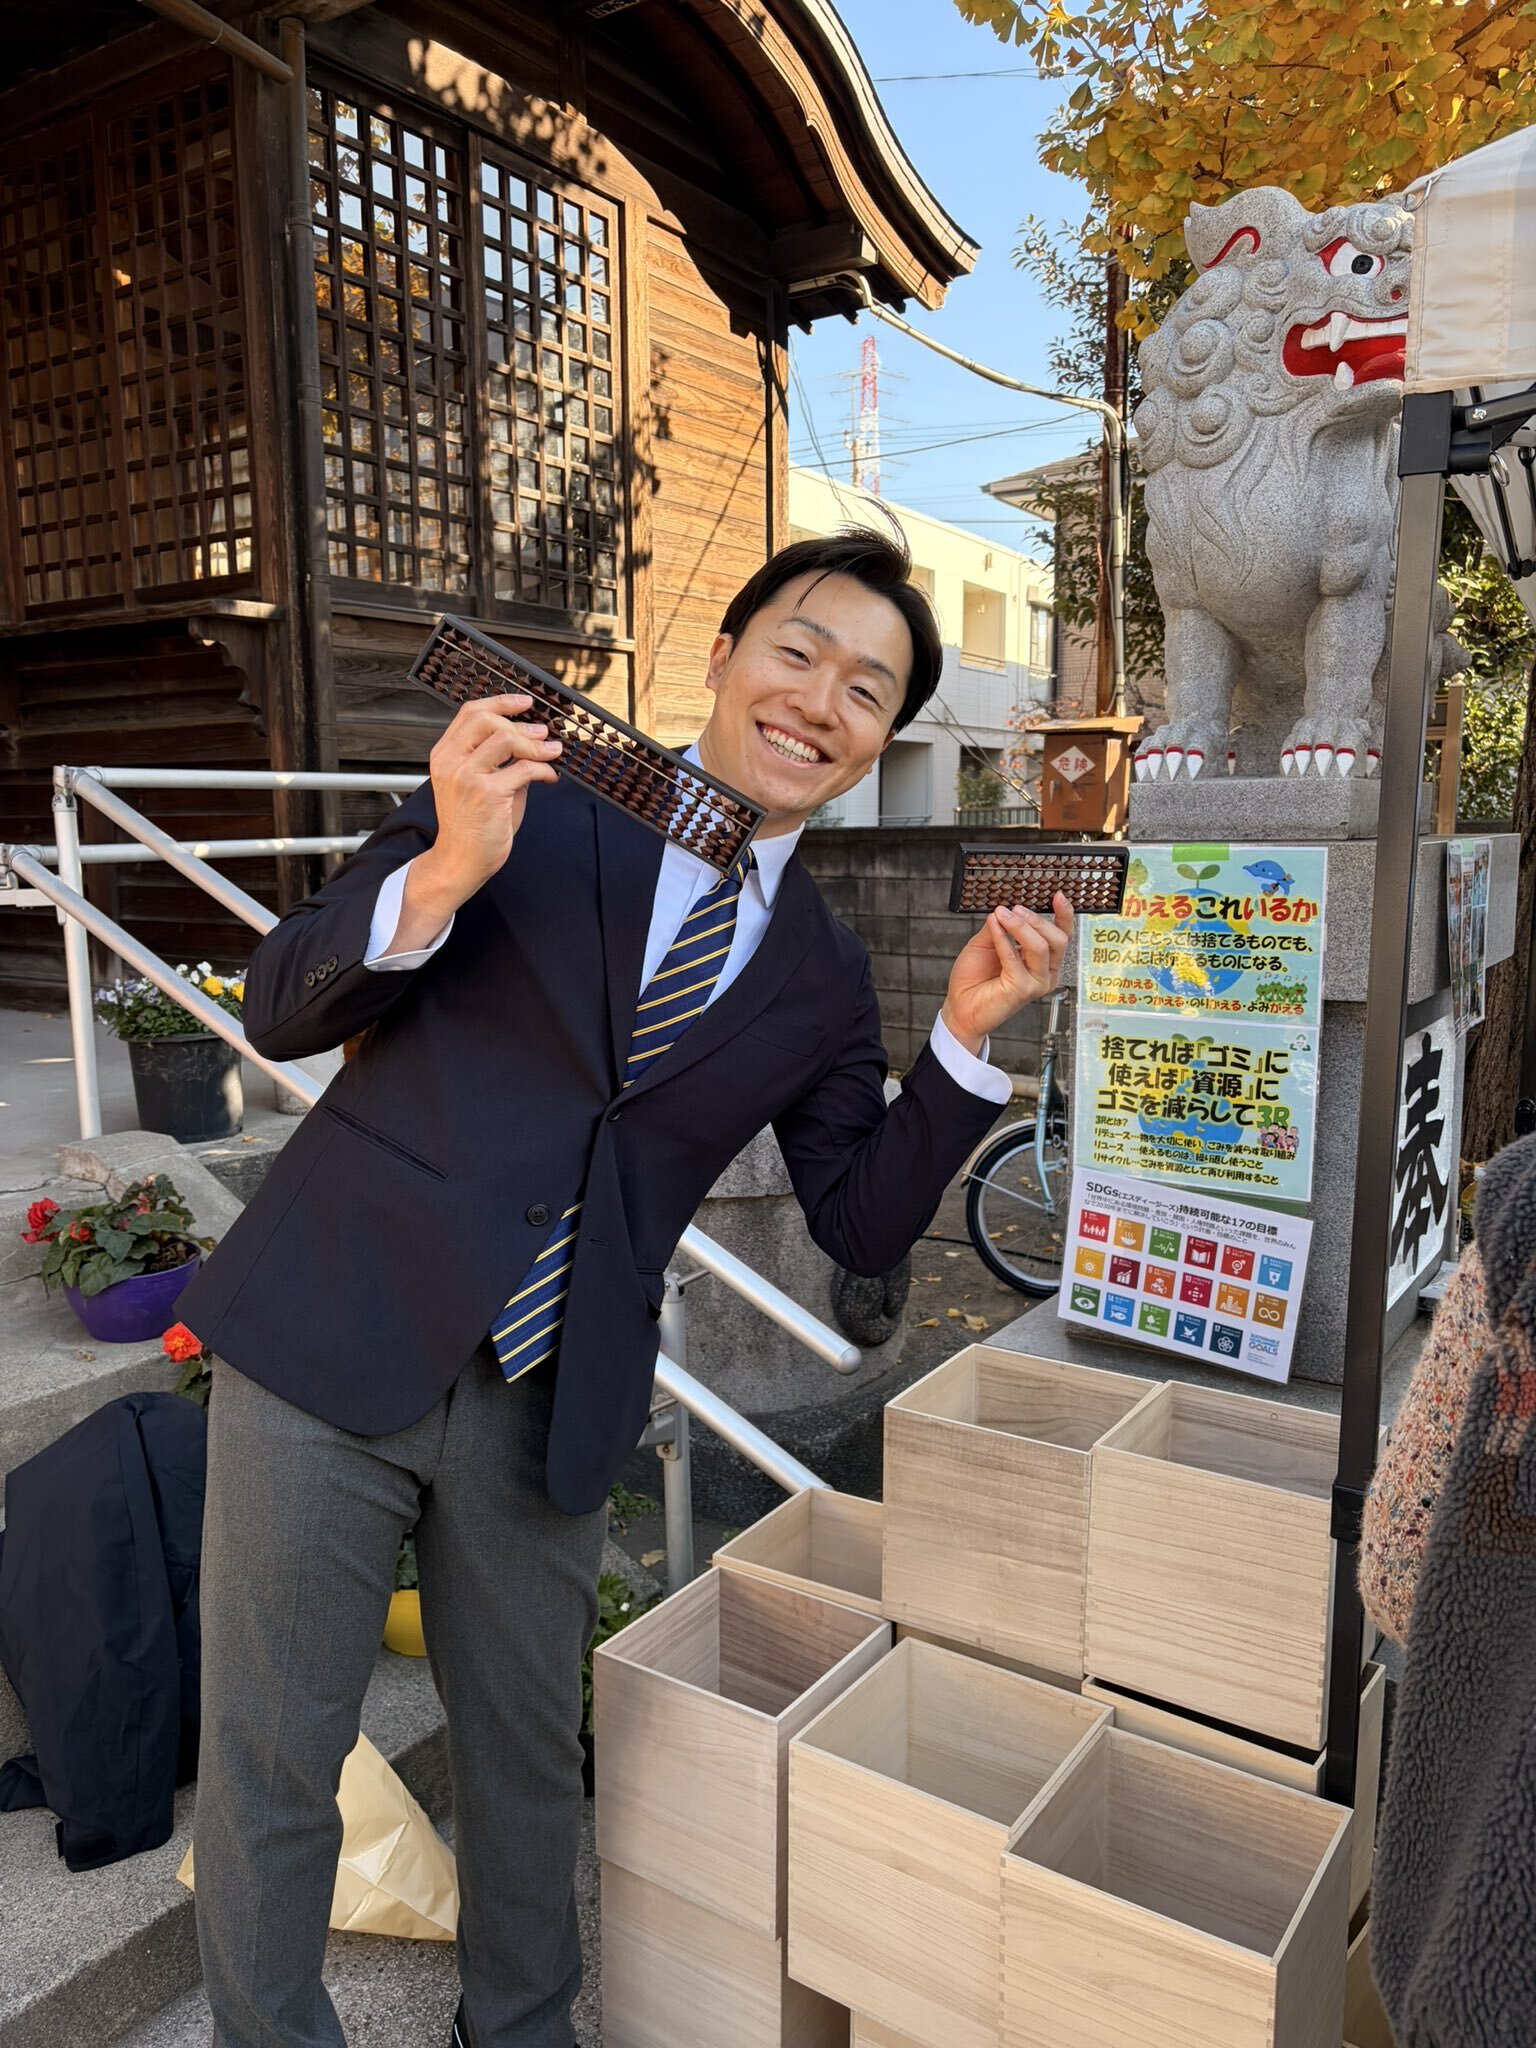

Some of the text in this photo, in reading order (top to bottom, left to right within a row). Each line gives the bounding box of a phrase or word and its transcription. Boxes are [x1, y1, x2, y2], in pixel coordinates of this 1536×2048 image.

[1058, 756, 1088, 772] 危険
[1122, 894, 1318, 923] かえるこれいるか
[1249, 1341, 1278, 1356] GOALS
